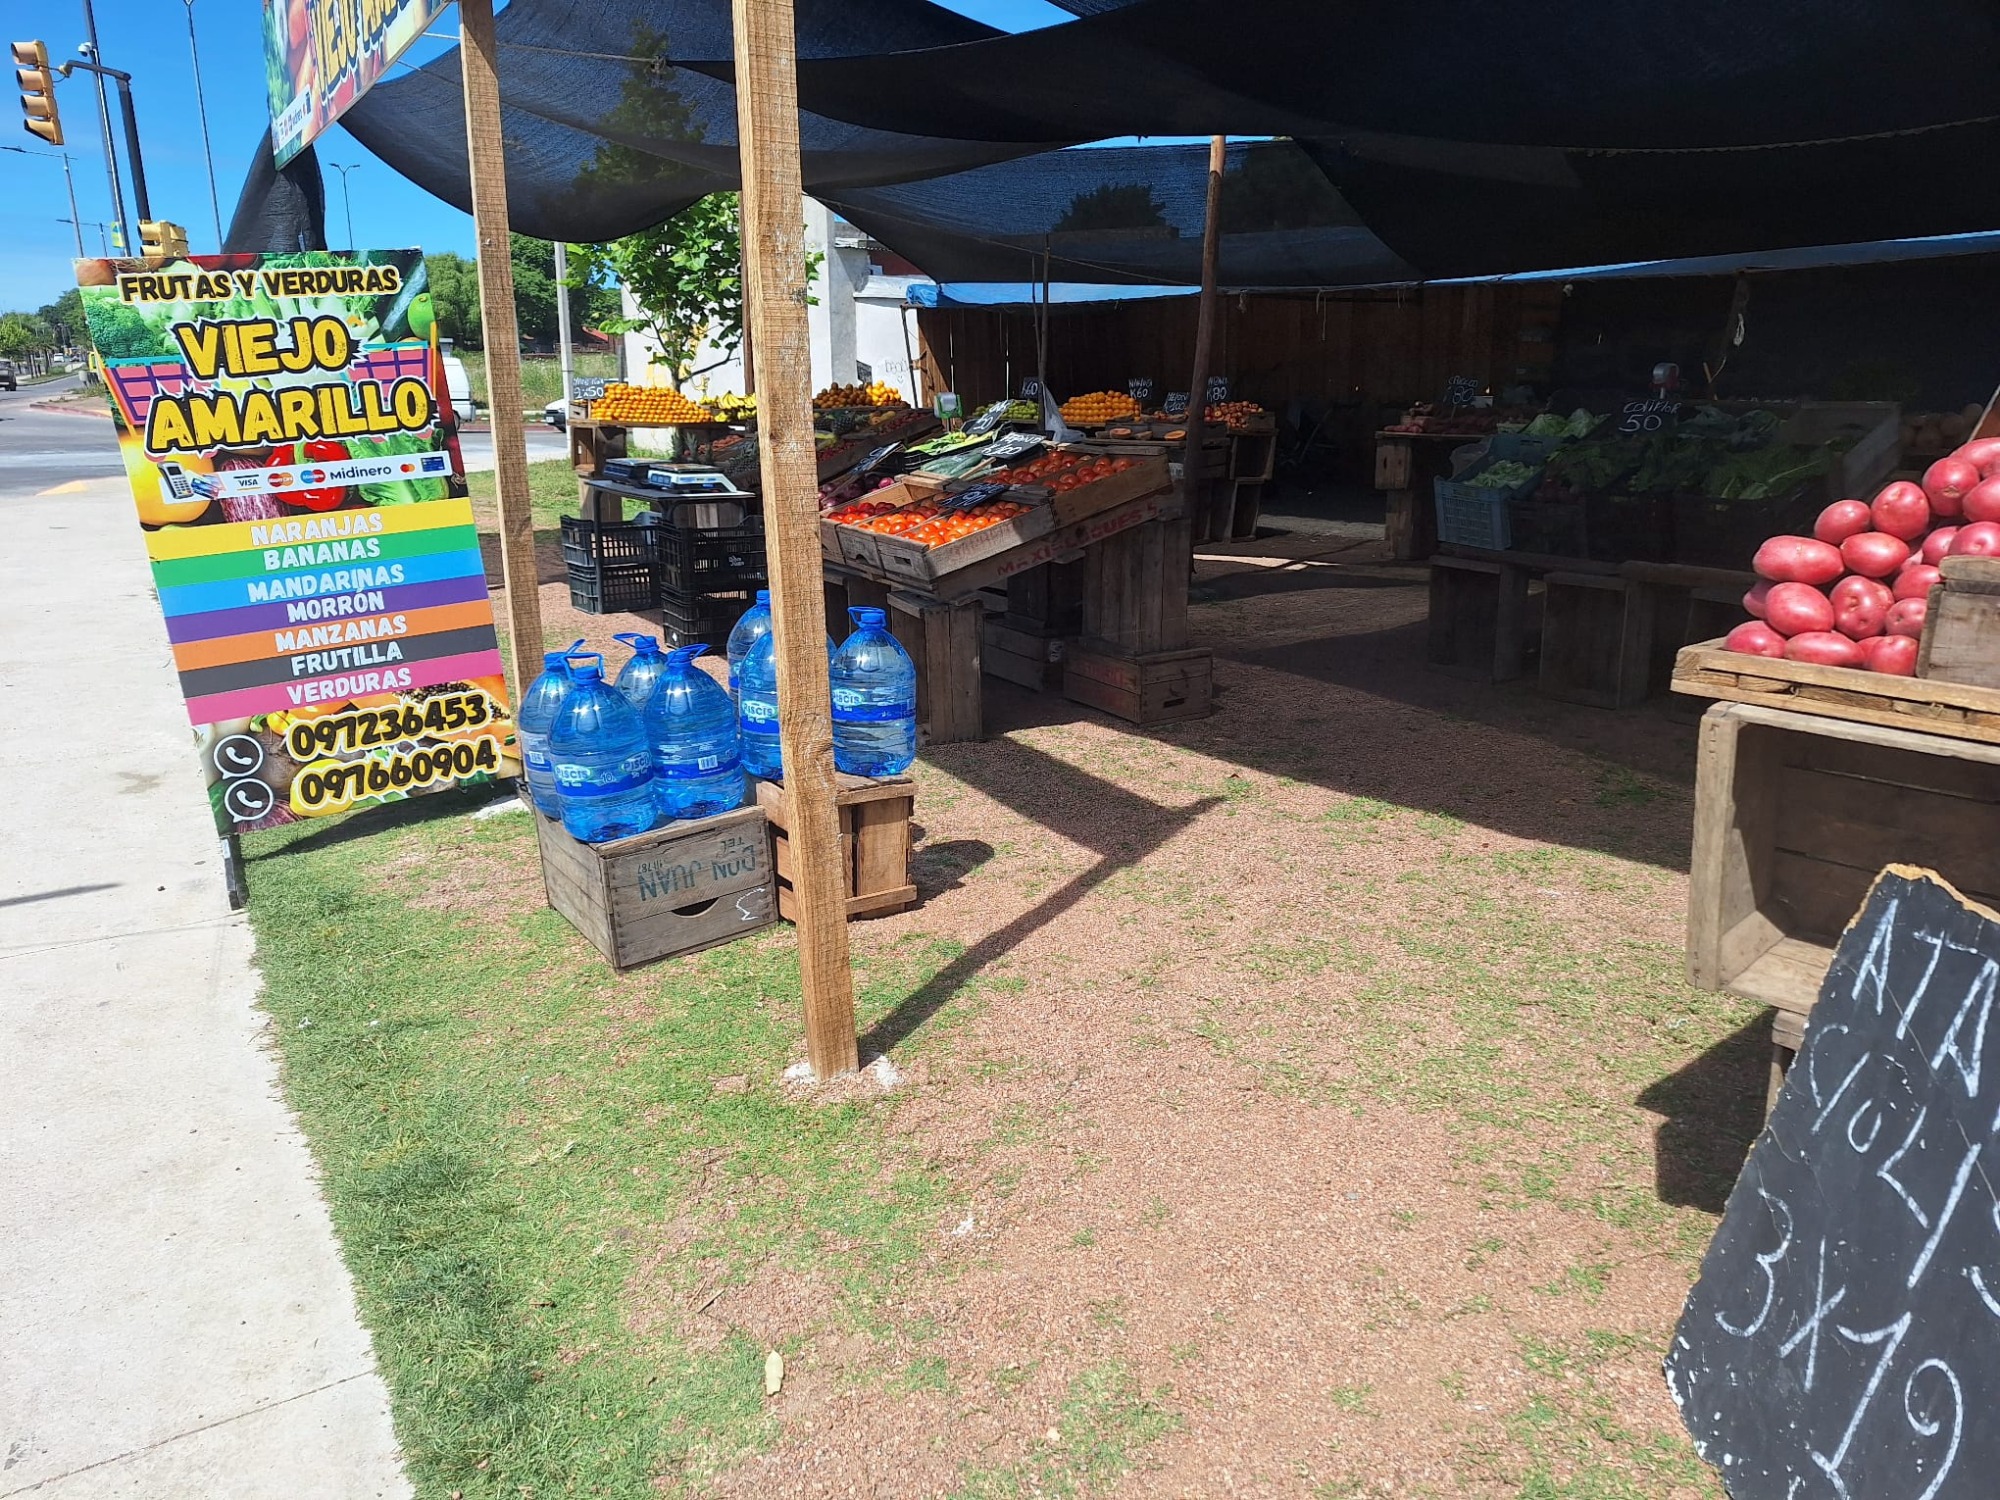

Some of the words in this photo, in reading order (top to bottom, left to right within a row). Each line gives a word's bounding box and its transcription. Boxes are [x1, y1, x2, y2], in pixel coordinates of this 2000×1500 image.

[120, 273, 232, 302] FRUTAS
[235, 272, 256, 298] Y
[262, 265, 399, 298] VERDURAS
[175, 316, 354, 377] VIEJO
[148, 379, 433, 452] AMARILLO
[1618, 414, 1662, 432] 50
[238, 478, 259, 488] VISA
[330, 466, 392, 480] Midinero
[250, 512, 384, 546] NARANJAS
[263, 537, 381, 571] BANANAS
[247, 563, 405, 603] MANDARINAS
[286, 588, 386, 623] MORRÓN
[274, 614, 408, 652] MANZANAS
[291, 641, 404, 677] FRUTILLA
[286, 667, 413, 705] VERDURAS
[290, 693, 489, 755] 097236453
[300, 738, 498, 806] 097660904
